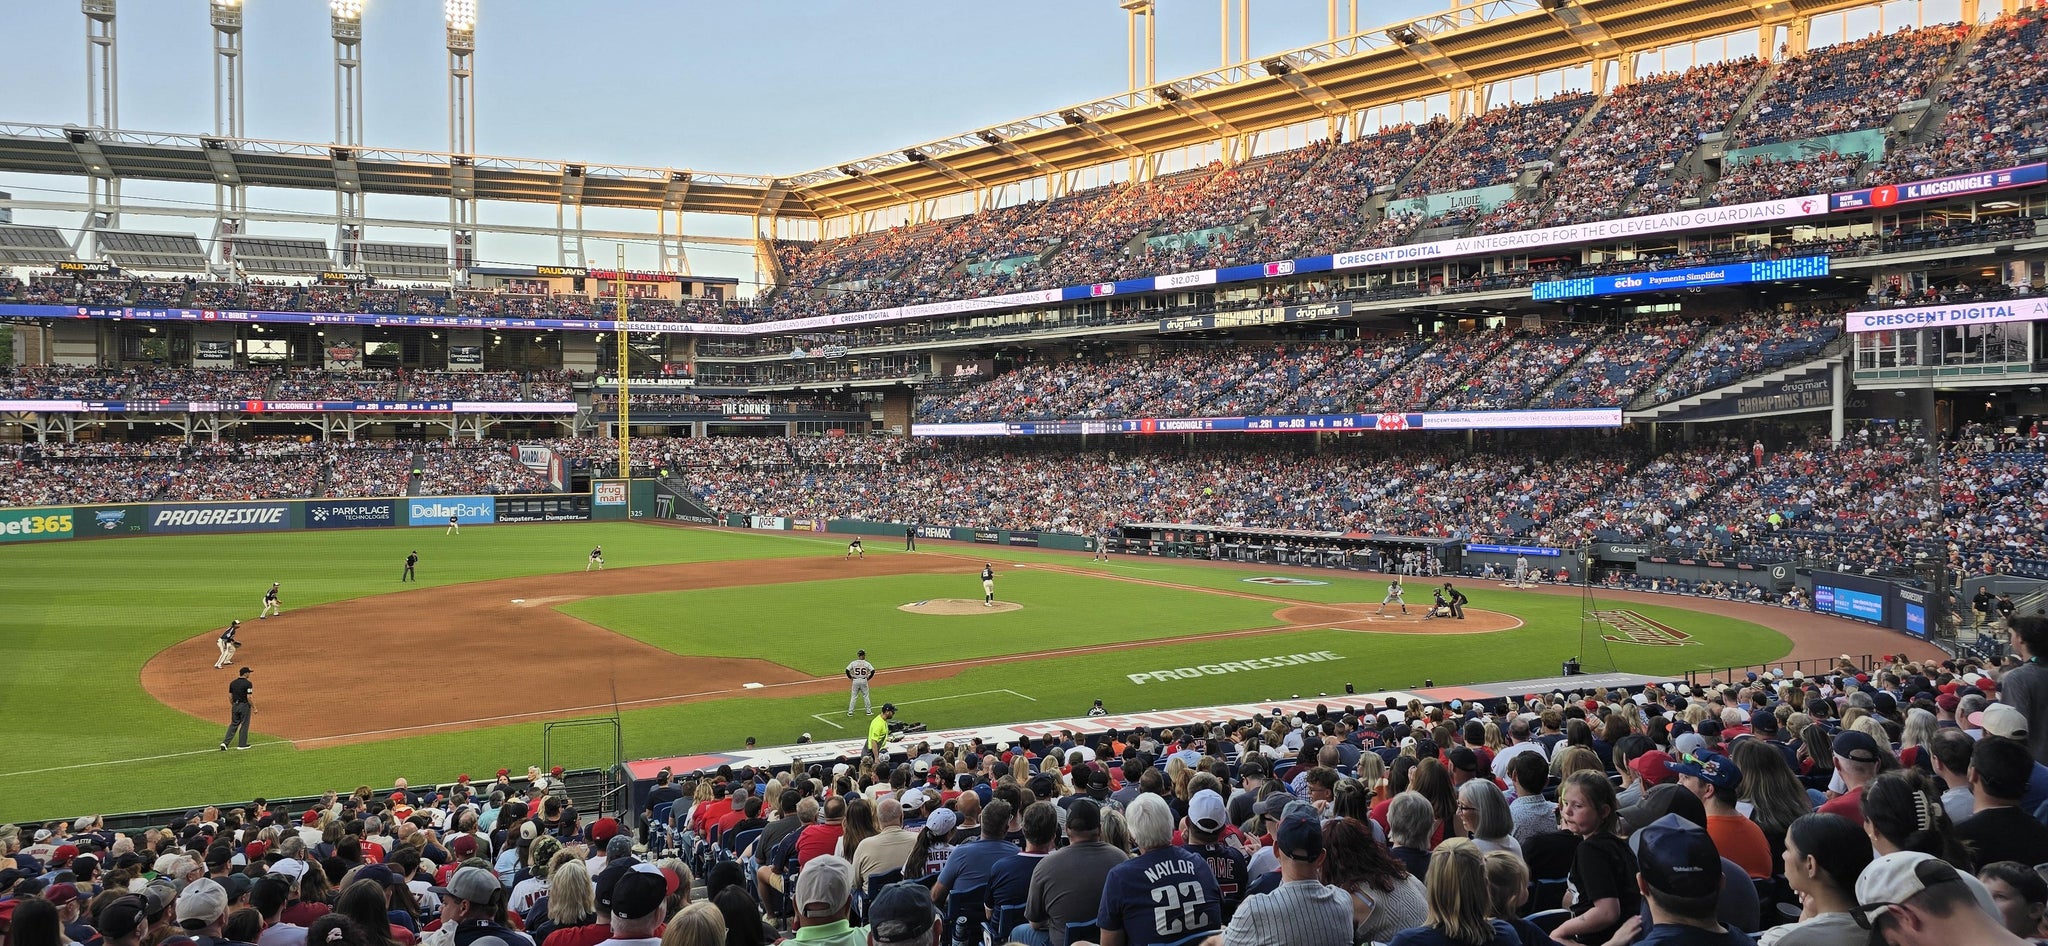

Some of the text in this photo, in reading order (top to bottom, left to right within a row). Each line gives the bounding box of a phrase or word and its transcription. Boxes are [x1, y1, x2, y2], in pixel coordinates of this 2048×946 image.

[1908, 175, 1992, 198] K. MCGONIGLE
[1451, 195, 1480, 208] LAJOIE
[1881, 190, 1888, 202] 7
[1340, 203, 1786, 265] CRESCENT DIGITAL AV INTEGRATOR FOR THE CLEVELAND GUARDIANS
[590, 268, 678, 282] PENNNT DISTRICT
[1615, 270, 1725, 288] echo Payments Simplified
[205, 310, 215, 318] 28
[841, 313, 868, 322] CRESCENT
[869, 311, 889, 320] DIGITAL
[1262, 308, 1285, 322] CLUB
[1296, 306, 1339, 318] drug mart
[1864, 311, 1947, 327] CRESCENT
[1951, 305, 2015, 321] DIGITAL
[1166, 318, 1203, 330] drug mart
[658, 378, 696, 386] BREWERY
[1782, 381, 1803, 393] drug
[1804, 379, 1828, 389] mart
[1737, 389, 1830, 414] CHAMPIONS CLUB
[722, 403, 771, 415] THE CORNER
[1166, 420, 1203, 430] MCGONIGLE
[1259, 419, 1273, 428] .281
[1289, 418, 1305, 428] .803
[1343, 418, 1354, 426] 24
[597, 483, 626, 503] drug mart
[154, 507, 287, 527] PROGRESSIVE
[333, 506, 390, 515] PARK PLACE
[345, 513, 390, 521] TECHNOLOGIES
[759, 517, 776, 529] ROSE
[855, 667, 867, 676] 56
[1127, 650, 1346, 685] PROGRESSIVE
[1362, 738, 1375, 752] 11
[1144, 859, 1195, 883] NAYLOR
[1206, 857, 1235, 879] OME
[1150, 880, 1209, 936] 22
